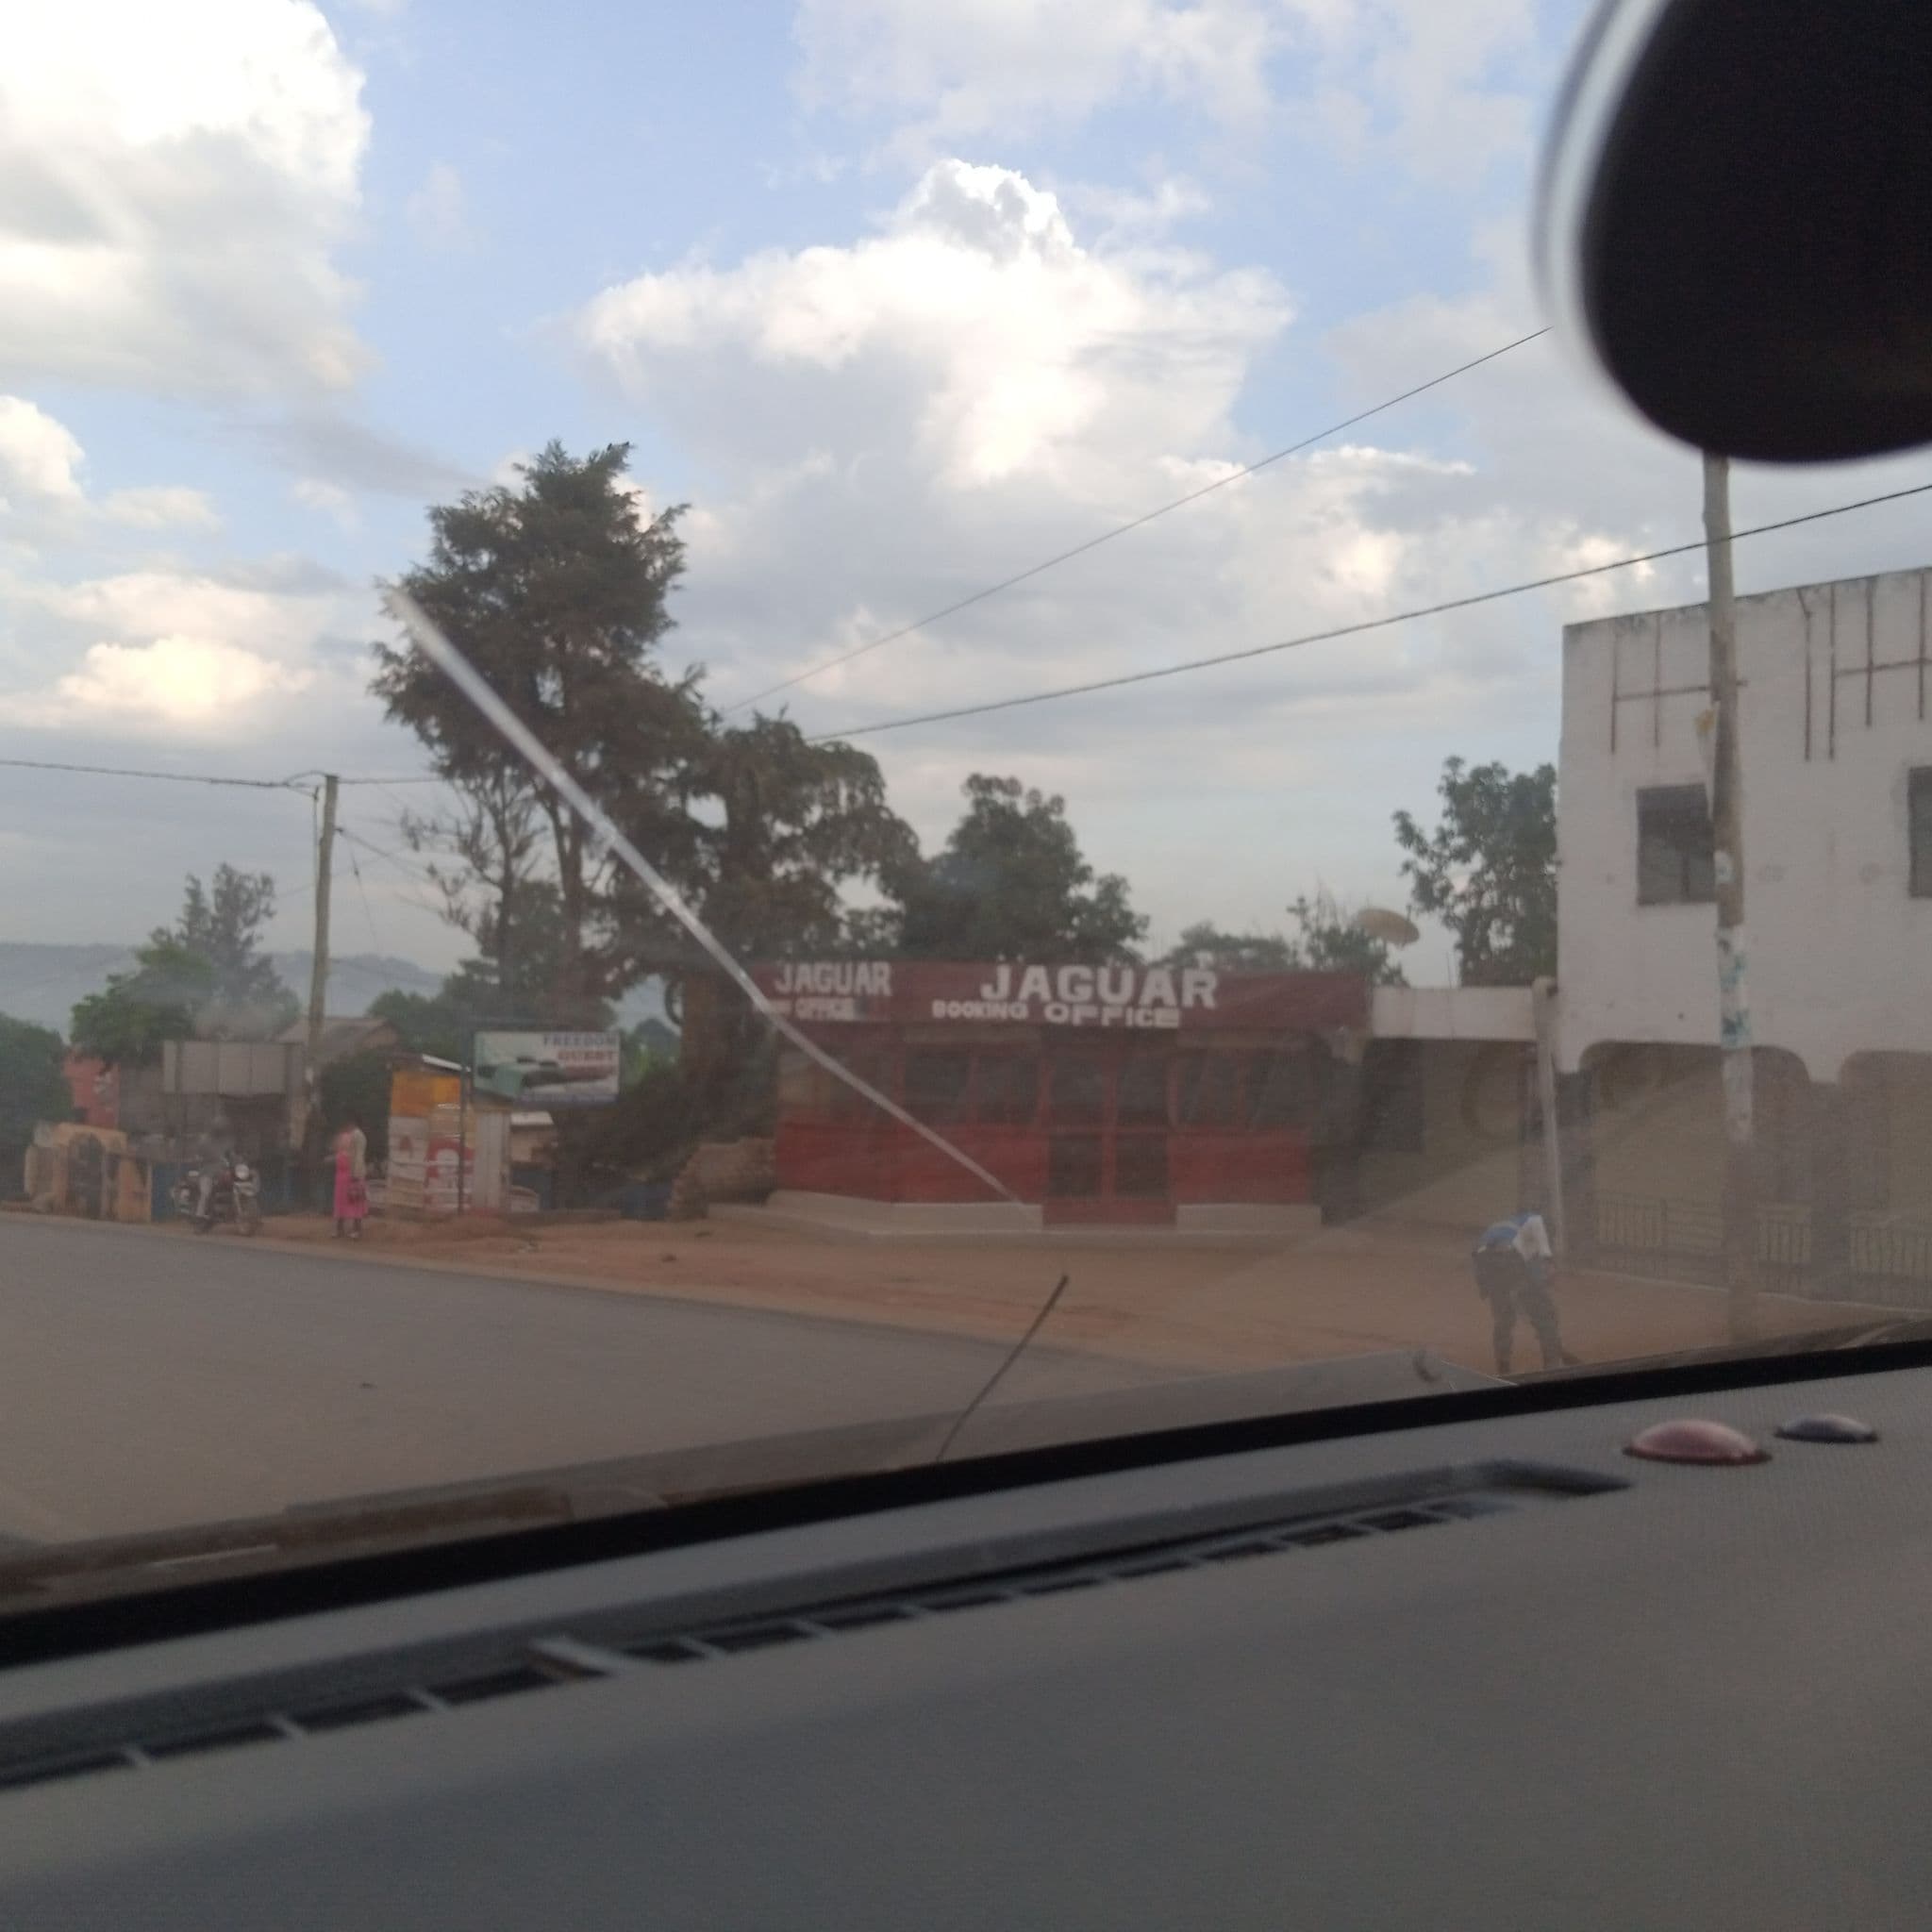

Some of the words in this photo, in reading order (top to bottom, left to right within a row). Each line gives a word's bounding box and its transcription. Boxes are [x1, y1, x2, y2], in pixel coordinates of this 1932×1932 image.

[774, 960, 892, 996] JAGUAR
[980, 963, 1217, 1008] JAGUAR
[932, 1000, 1028, 1020] BOOKING
[1043, 1002, 1180, 1028] OFFICE
